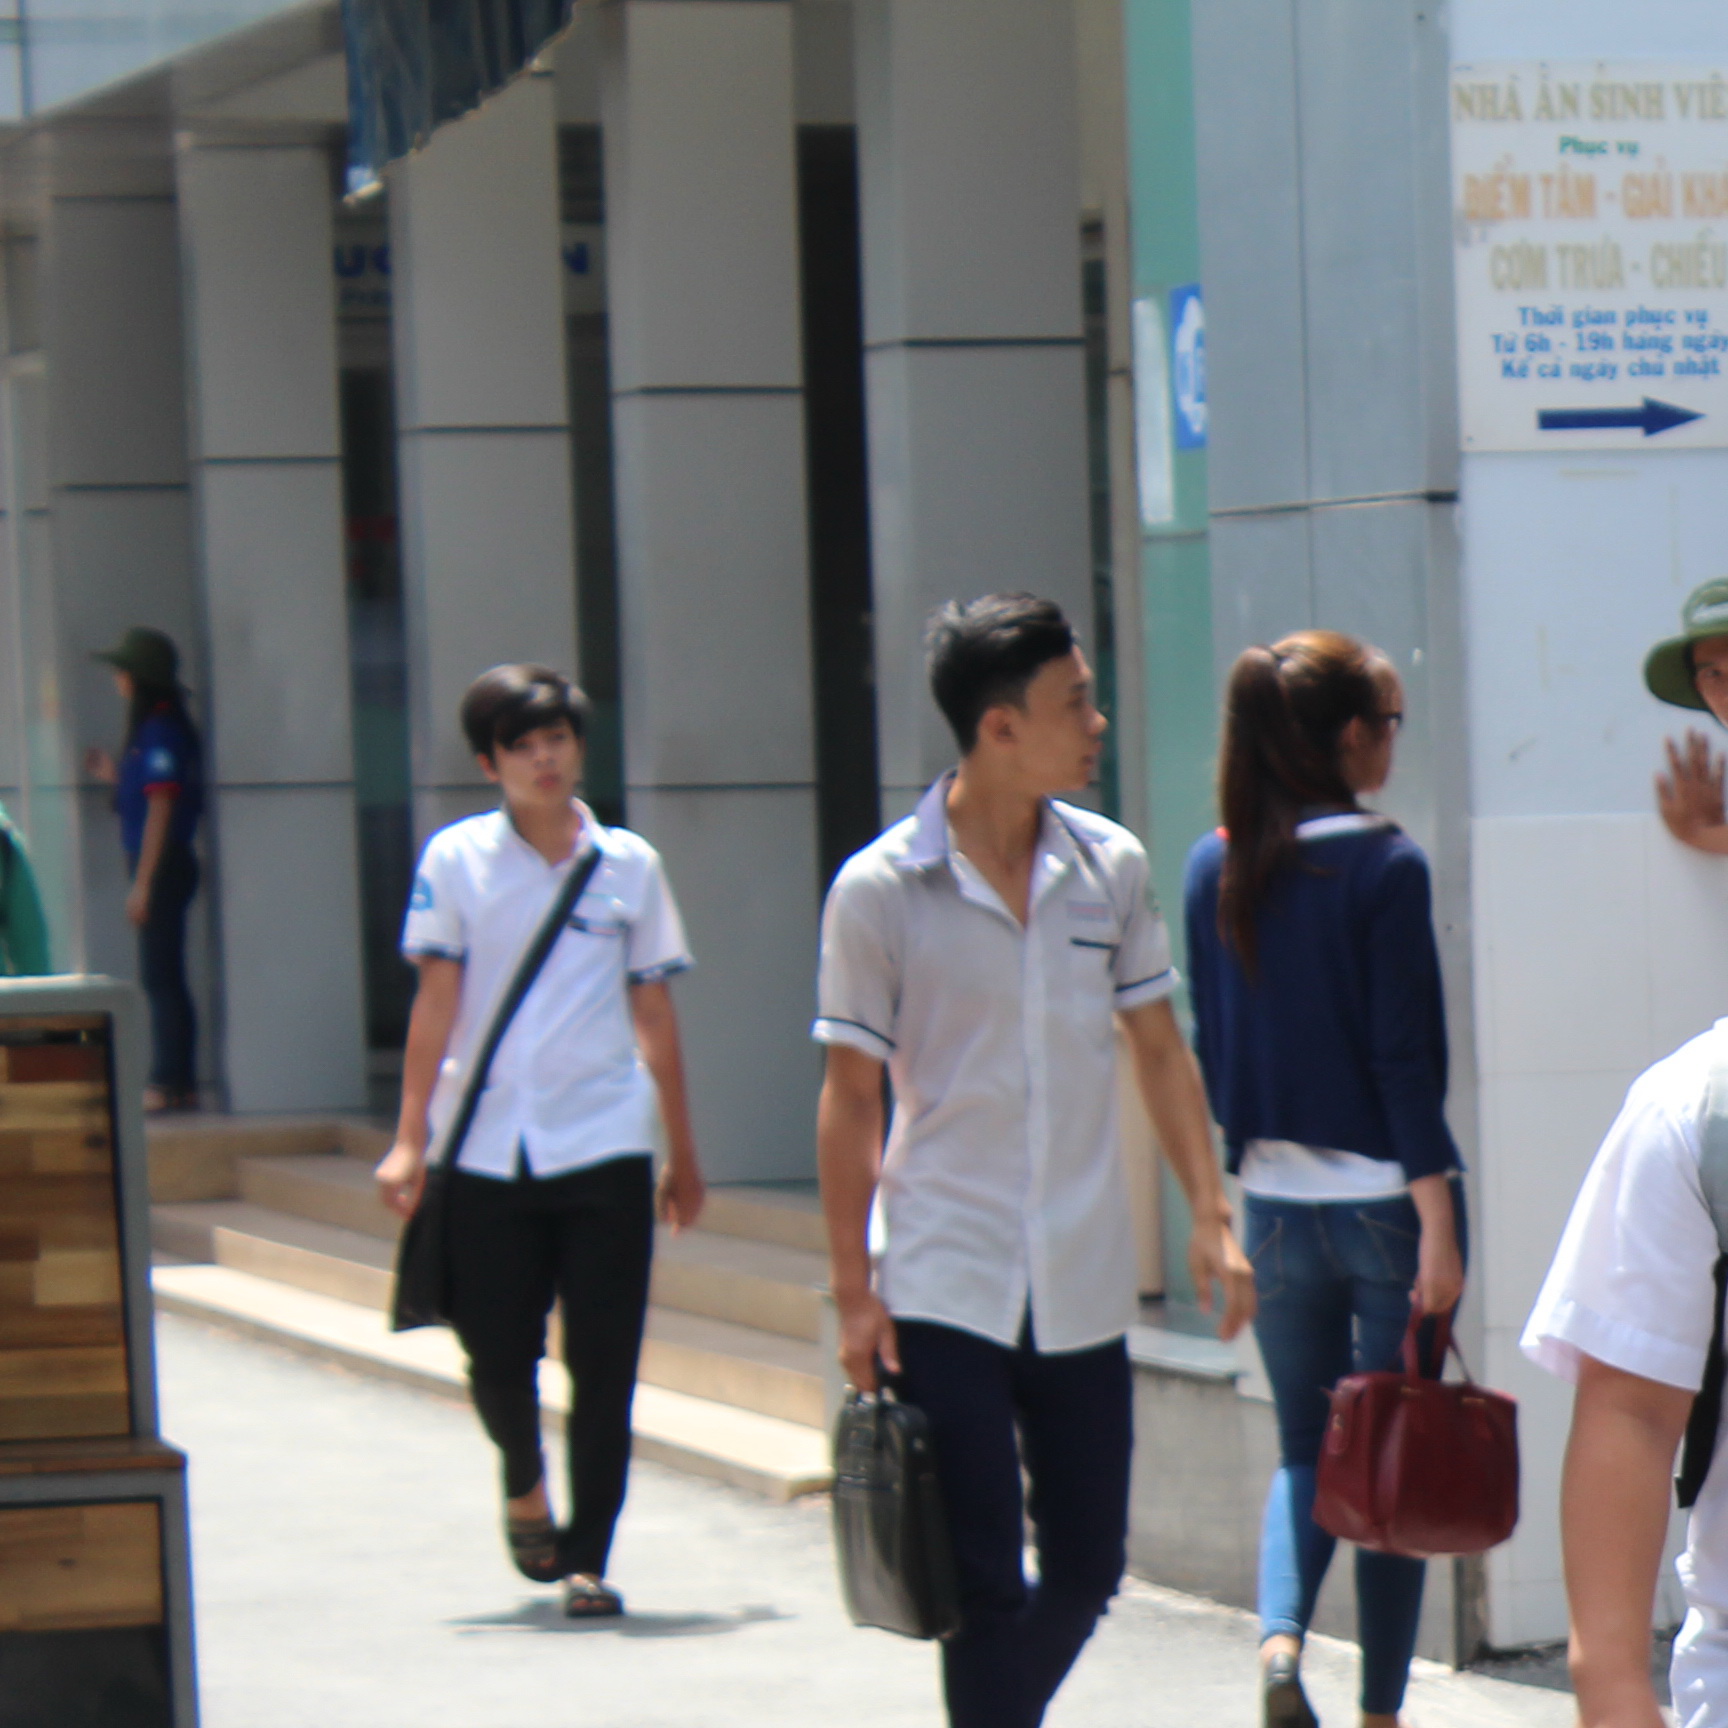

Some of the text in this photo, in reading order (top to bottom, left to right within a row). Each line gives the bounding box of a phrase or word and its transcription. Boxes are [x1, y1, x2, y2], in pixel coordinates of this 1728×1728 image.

[1589, 81, 1666, 121] SINH
[1572, 306, 1616, 331] gian
[1626, 305, 1677, 332] phục
[1525, 331, 1552, 353] 6h
[1576, 330, 1615, 353] 19h
